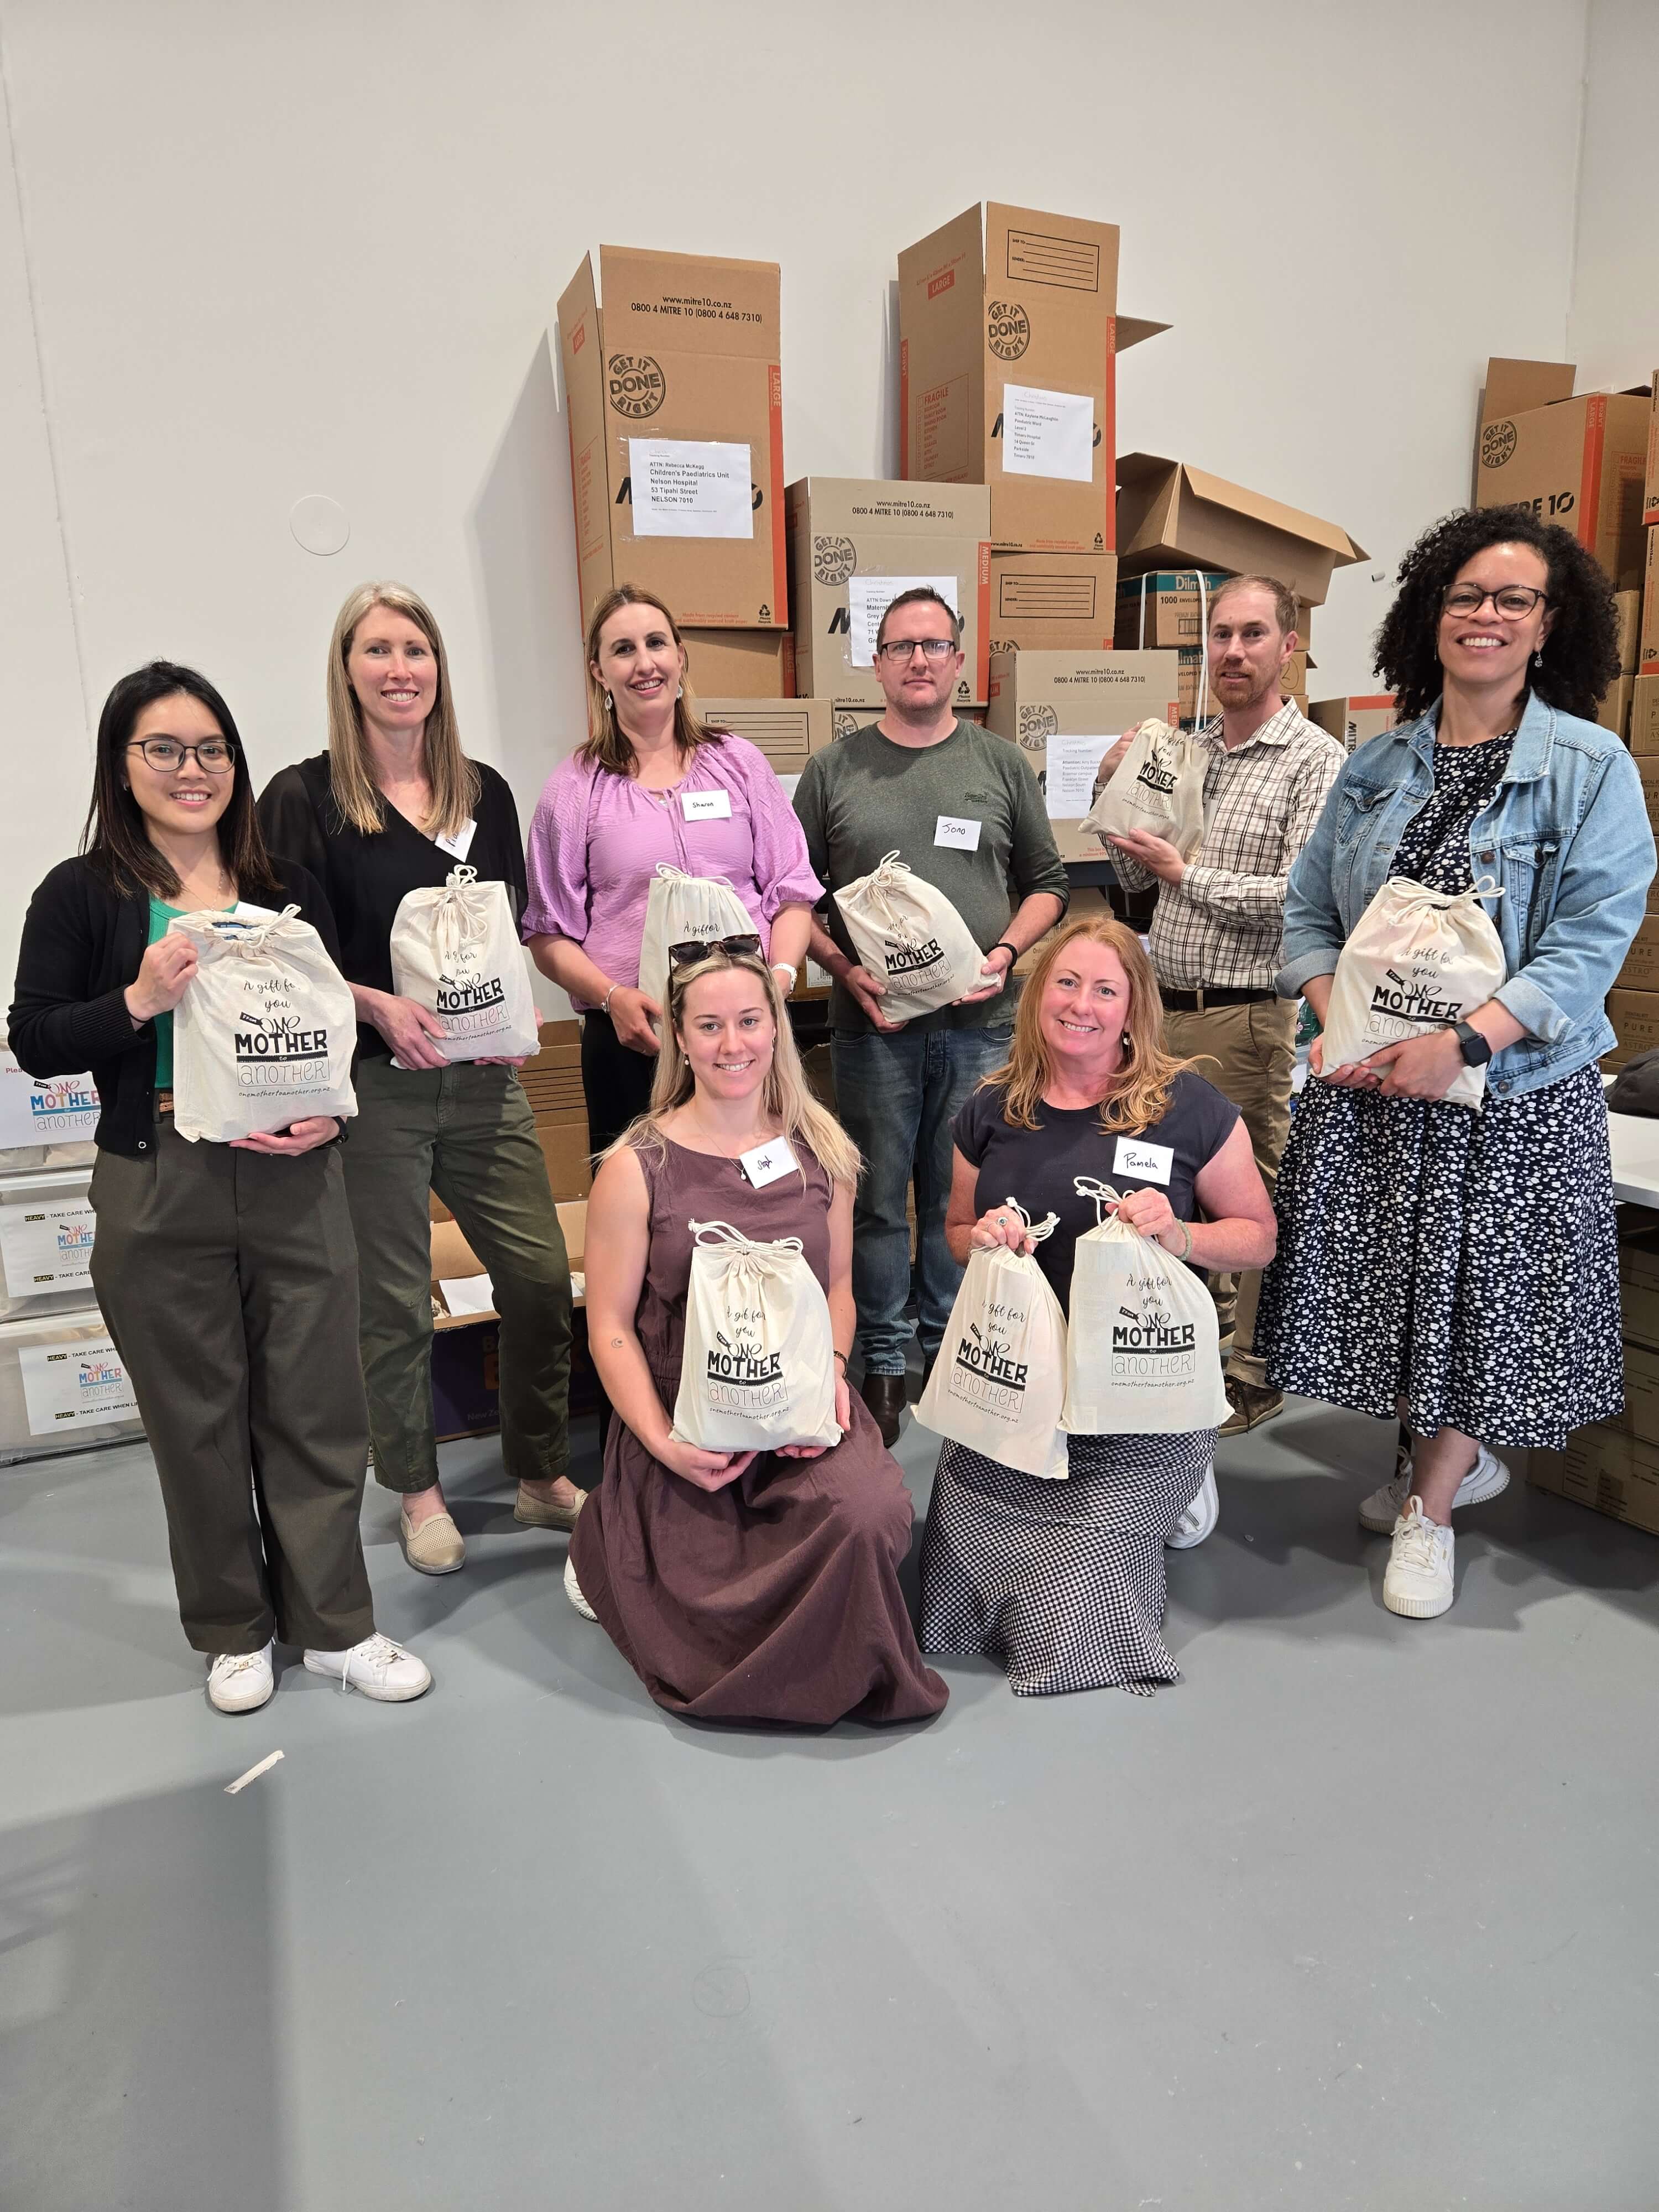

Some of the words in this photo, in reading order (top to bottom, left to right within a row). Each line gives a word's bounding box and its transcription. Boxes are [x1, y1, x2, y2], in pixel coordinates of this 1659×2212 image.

[932, 274, 951, 293] LARGE
[662, 296, 732, 309] www.mitre10.co.nz
[632, 302, 651, 312] 0800
[660, 305, 681, 315] MITRE
[685, 308, 693, 316] 10
[696, 308, 717, 319] (0800
[719, 311, 723, 319] 4
[726, 311, 739, 320] 648
[742, 313, 763, 324] 7310)
[991, 304, 1008, 320] GET
[1010, 306, 1020, 317] IT
[988, 320, 1027, 338] DONE
[993, 336, 1025, 356] RIGHT
[613, 357, 634, 375] GET
[638, 358, 651, 372] IT
[609, 373, 661, 395] DONE
[773, 372, 781, 407] LARGE
[617, 392, 659, 414] RIGHT
[924, 387, 949, 406] FRAGILE
[1485, 424, 1499, 441] GET
[1500, 424, 1509, 433] IT
[1482, 431, 1514, 455] DONE
[1485, 446, 1511, 465] RIGHT
[877, 500, 930, 509] www.mitre10.co.nz
[1548, 492, 1575, 516] 10
[902, 509, 919, 517] (0800
[937, 510, 954, 519] 7310)
[816, 536, 832, 551] GET
[834, 536, 846, 548] IT
[814, 548, 853, 567] DONE
[981, 546, 990, 585] MEDIUM
[818, 563, 851, 582] RIGHT
[1176, 575, 1211, 591] Dilmh
[1161, 596, 1177, 604] 1000
[989, 641, 1002, 654] ET
[1003, 641, 1013, 653] IT
[1021, 705, 1036, 719] GET
[1038, 705, 1048, 714] IT
[1019, 716, 1055, 734] DONE
[942, 823, 966, 835] Jono
[684, 921, 691, 932] A
[885, 938, 942, 969] MOTHER
[1412, 948, 1438, 961] gift
[1412, 967, 1439, 979] you
[257, 979, 282, 994] gift
[436, 977, 504, 1009] MOTHER
[265, 999, 291, 1013] you
[1373, 985, 1463, 1019] MOTHER
[1624, 1022, 1653, 1033] PURE
[234, 1029, 328, 1055] MOTHER
[30, 1090, 101, 1110] MOTHER
[238, 1087, 331, 1098] onemothertoanother.org.nz
[1124, 1152, 1158, 1170] Pamela
[58, 1232, 94, 1246] MOTHE
[34, 1274, 54, 1282] HEAVY
[1126, 1273, 1136, 1287] A
[1139, 1277, 1156, 1291] gift
[1156, 1276, 1172, 1290] for
[1142, 1296, 1163, 1309] you
[752, 1310, 766, 1323] for
[1006, 1308, 1026, 1323] for
[988, 1322, 1007, 1334] you
[1113, 1323, 1195, 1347] MOTHER
[47, 1353, 67, 1361] HEAVY
[708, 1350, 781, 1378] MOTHER
[958, 1338, 1028, 1384] MOTHER
[79, 1368, 122, 1384] MOTHER
[1111, 1379, 1195, 1387] onemothertoanother.org.nz
[709, 1406, 790, 1420] onemothertoanother.org.nz
[948, 1389, 1019, 1424] onemothertoanother.org.nz
[55, 1411, 75, 1420] HEAVY
